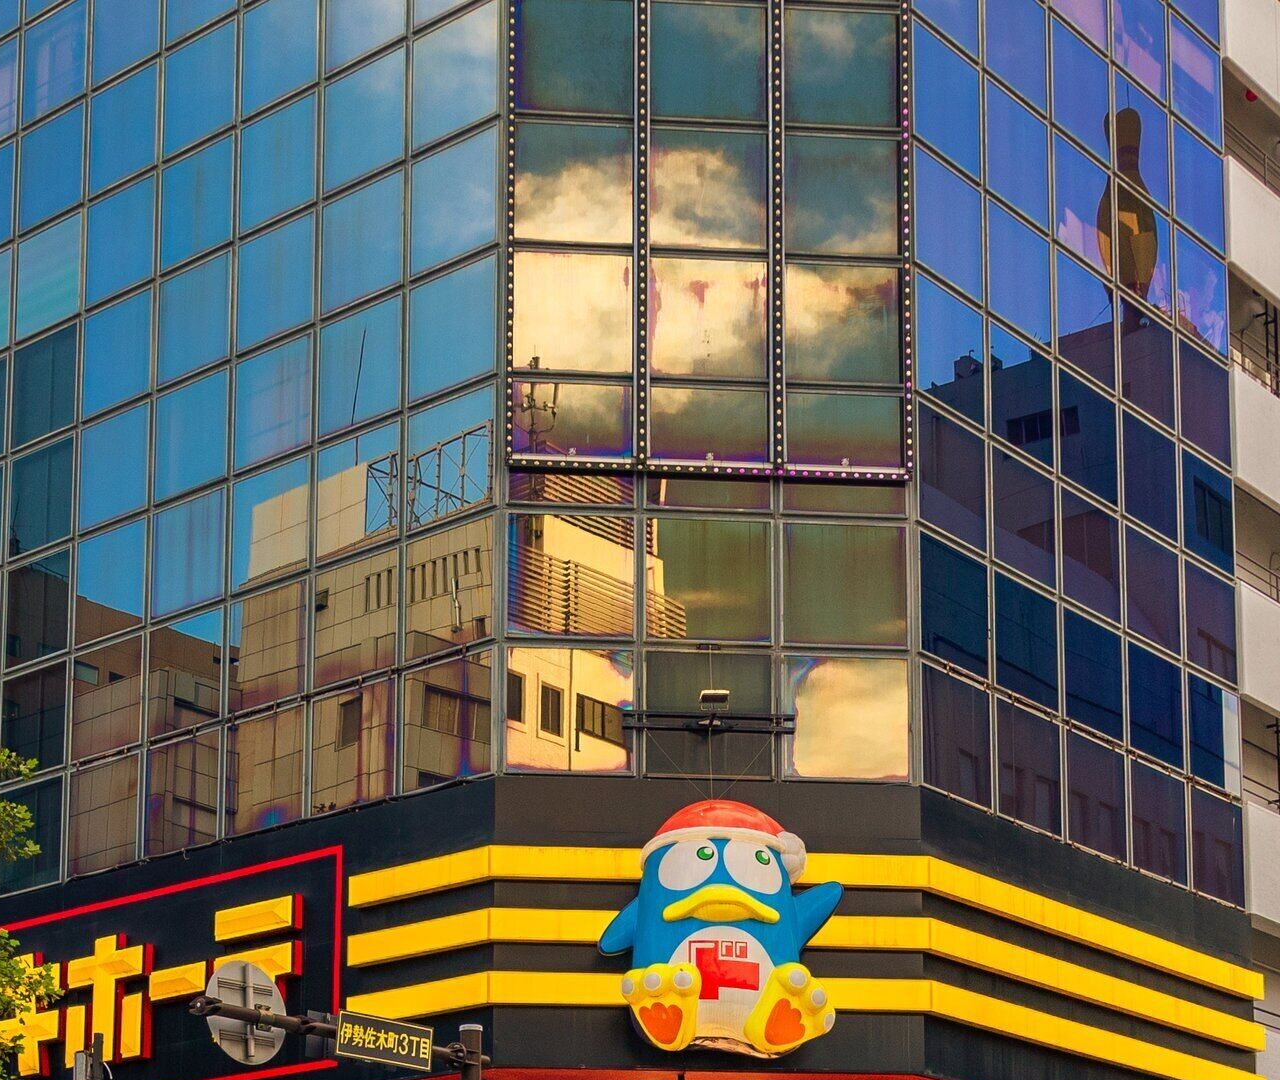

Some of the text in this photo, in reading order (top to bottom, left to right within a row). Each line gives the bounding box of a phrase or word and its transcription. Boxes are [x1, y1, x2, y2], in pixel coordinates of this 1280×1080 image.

[340, 1022, 430, 1059] 伊勢佐木町3丁目
